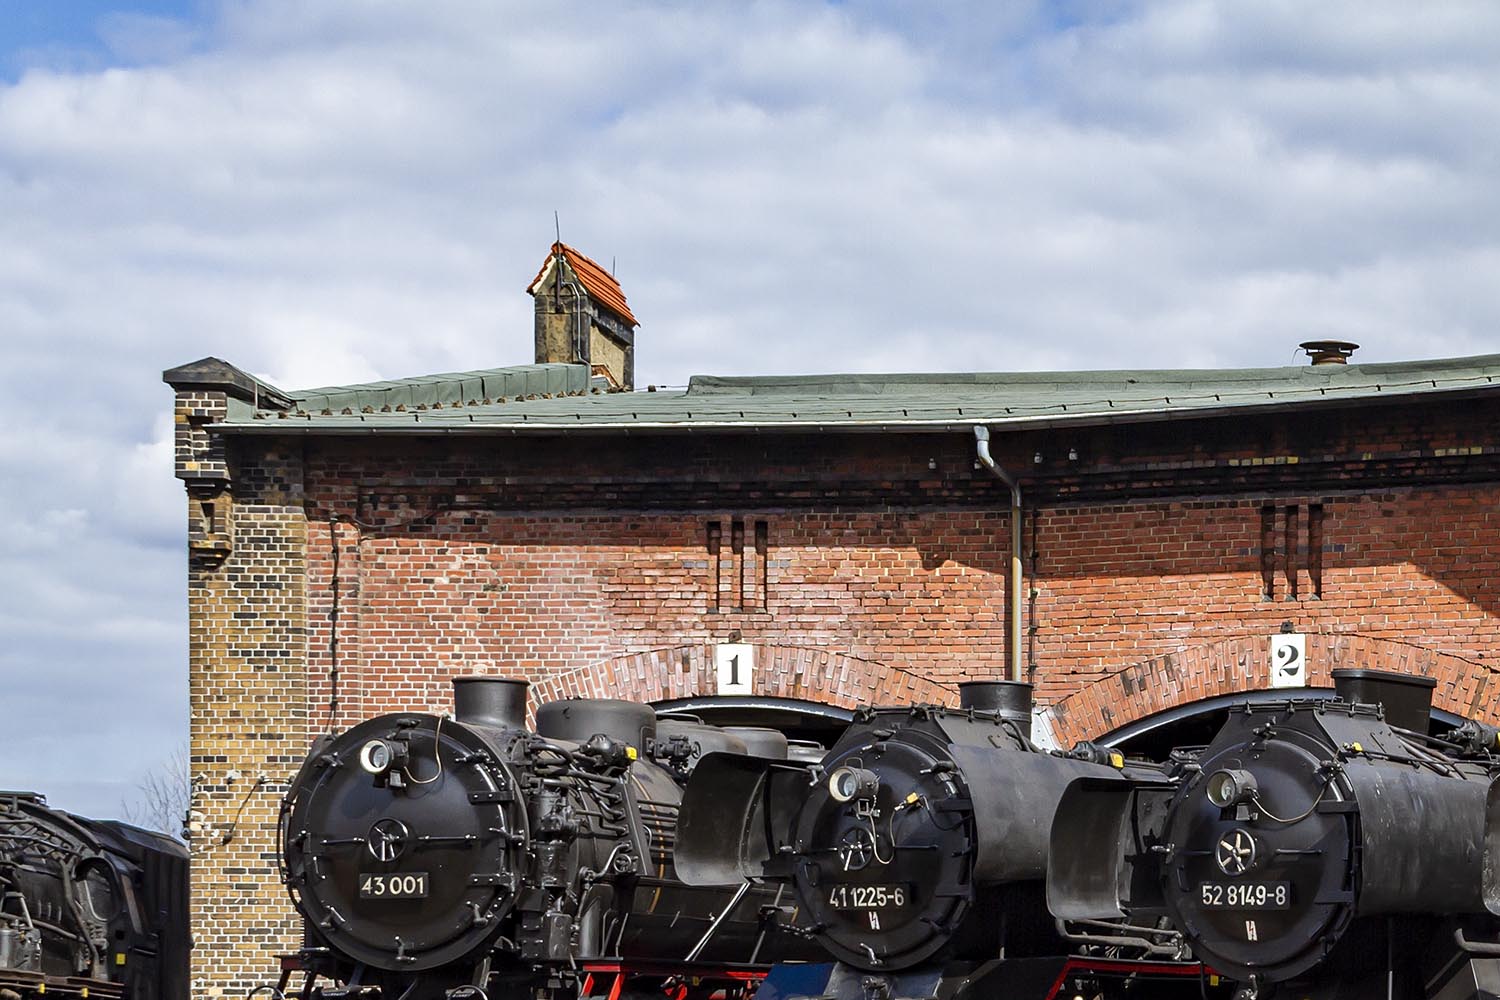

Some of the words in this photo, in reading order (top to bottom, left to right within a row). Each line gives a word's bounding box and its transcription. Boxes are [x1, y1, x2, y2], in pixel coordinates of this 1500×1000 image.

[725, 654, 744, 686] 1
[1277, 644, 1300, 677] 2
[361, 876, 386, 896] 43
[389, 875, 424, 895] 001
[1202, 885, 1223, 905] 52
[1227, 885, 1287, 906] 8149-8
[829, 887, 847, 907] 41
[850, 886, 905, 907] 1225-6
